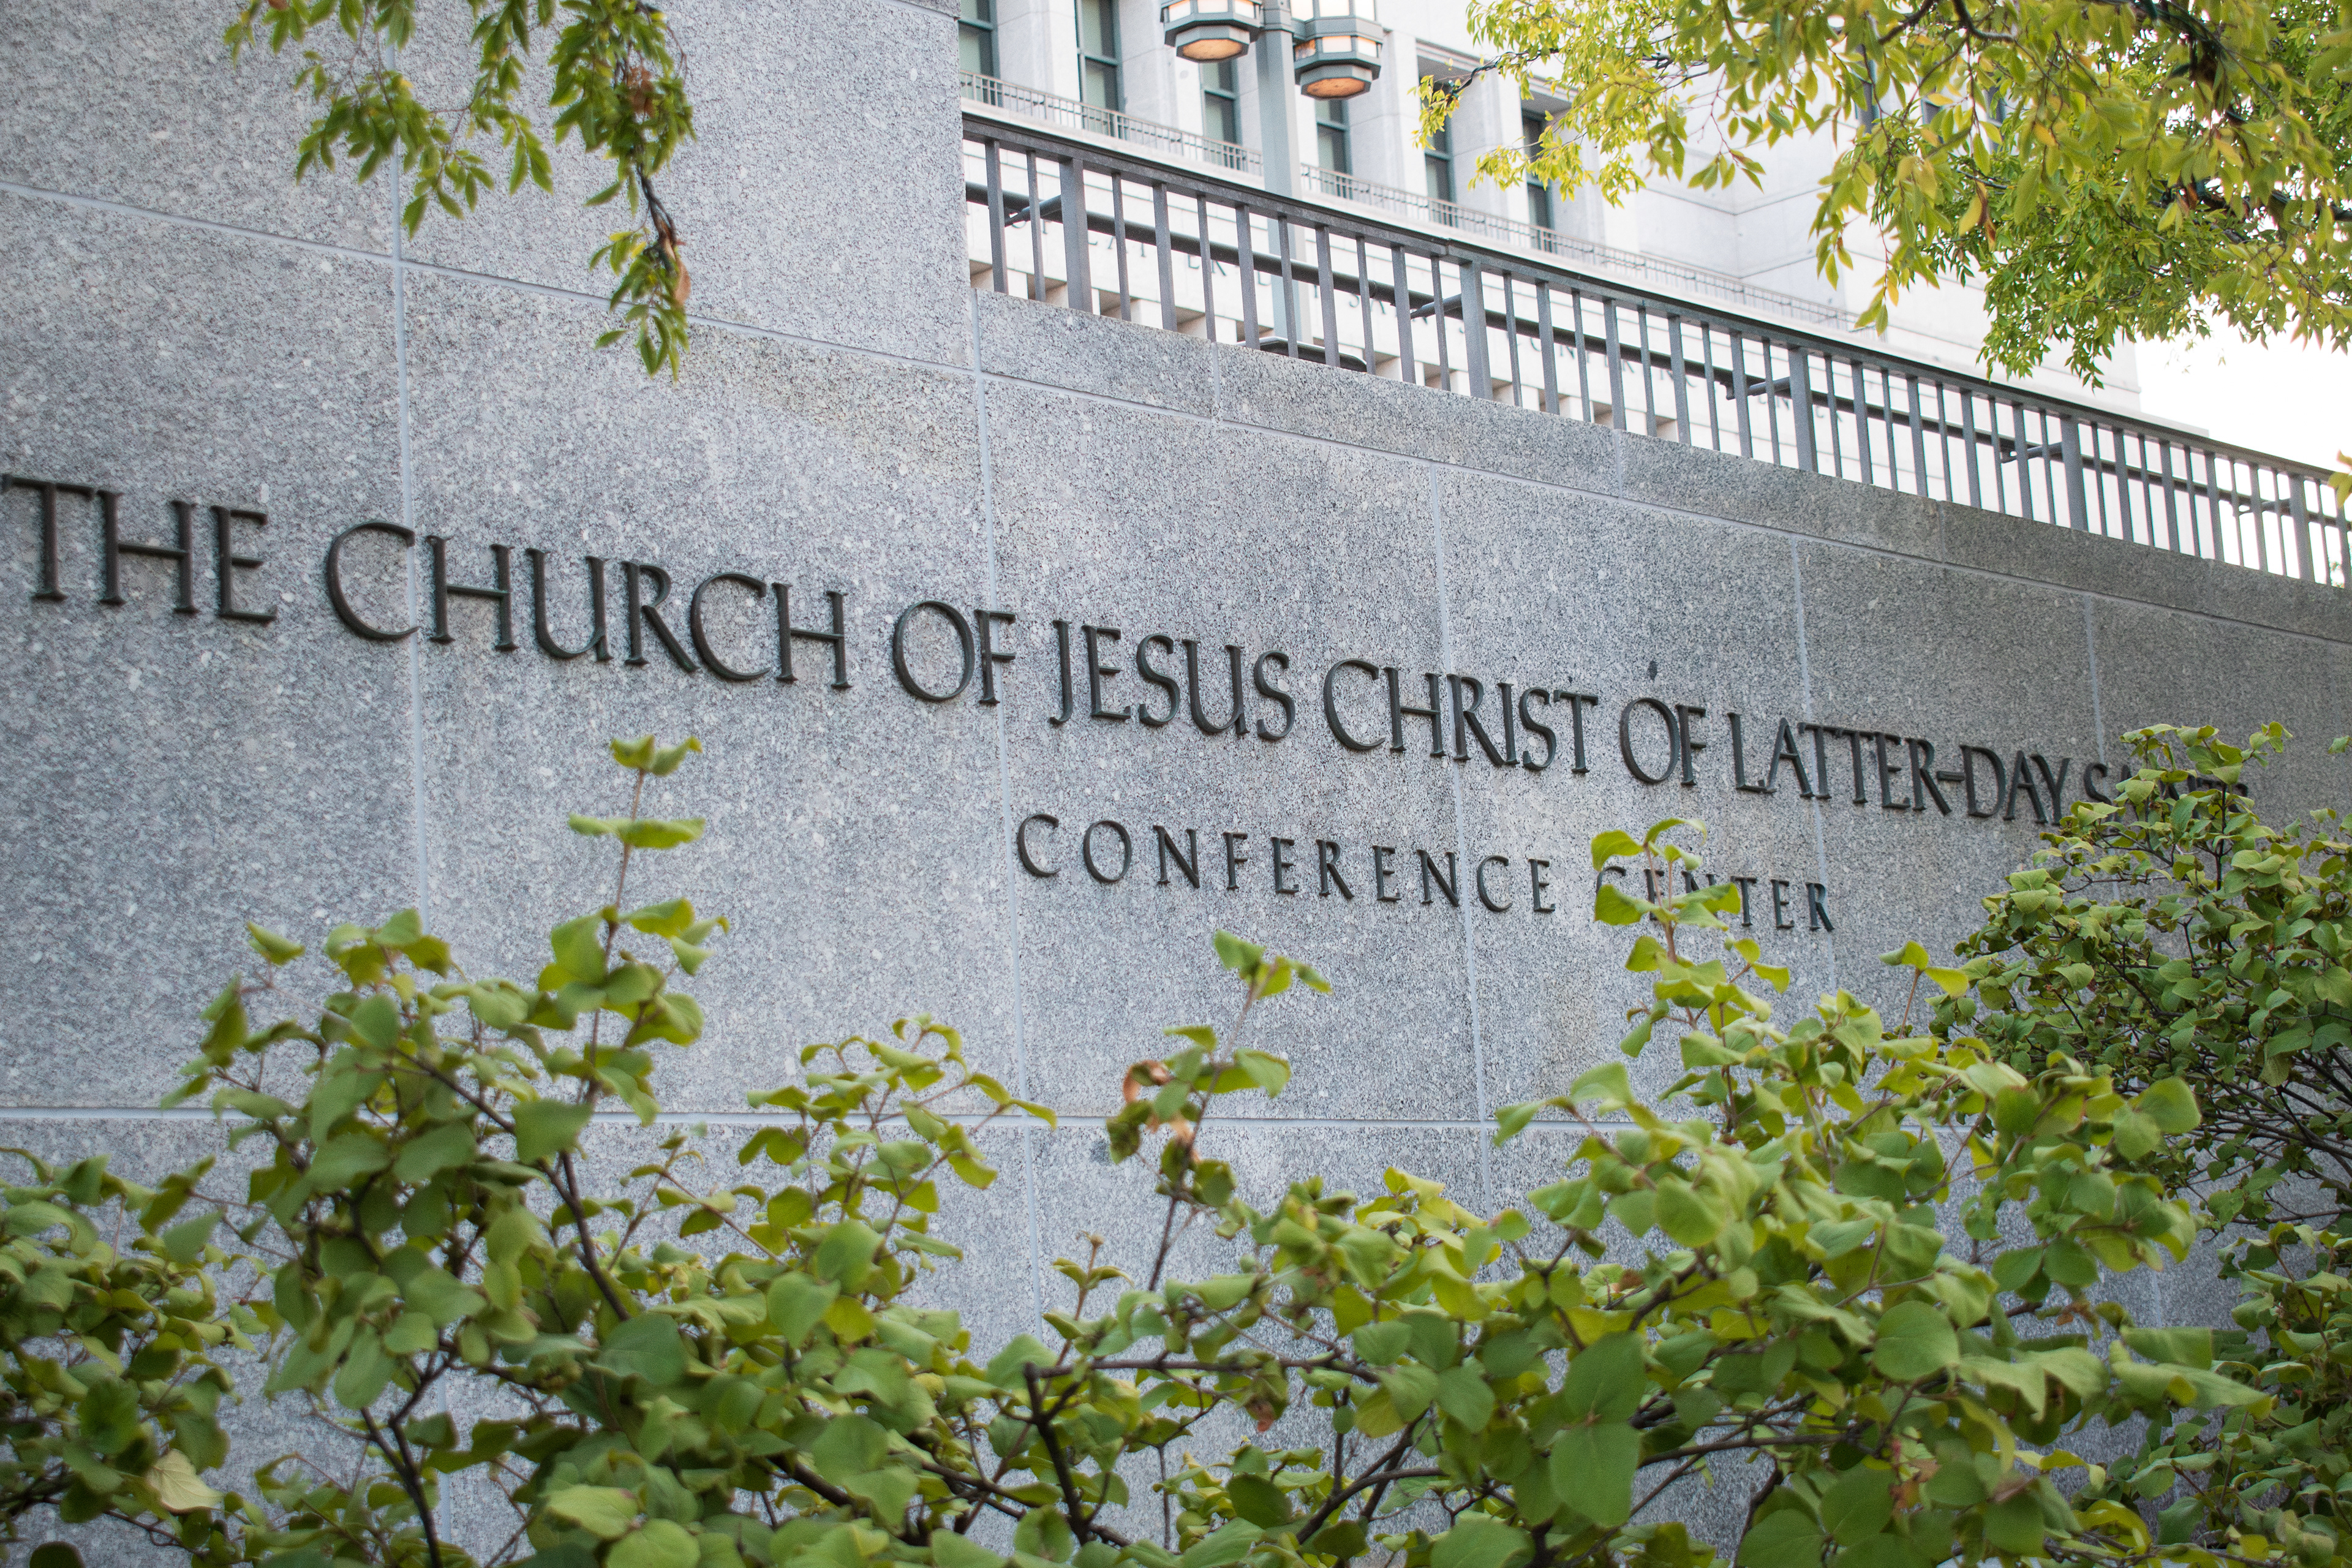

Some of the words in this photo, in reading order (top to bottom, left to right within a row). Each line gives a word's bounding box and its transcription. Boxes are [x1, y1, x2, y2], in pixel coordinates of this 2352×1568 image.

[0, 473, 277, 625] THE
[325, 519, 851, 691] CHURCH
[892, 600, 1016, 704] OF
[1049, 619, 1297, 740] JESUS
[1322, 657, 1598, 774] CHRIST
[1619, 697, 1707, 786] OF
[1727, 712, 2071, 826] LATTER-DAY
[1017, 813, 1556, 913] CONFERENCE
